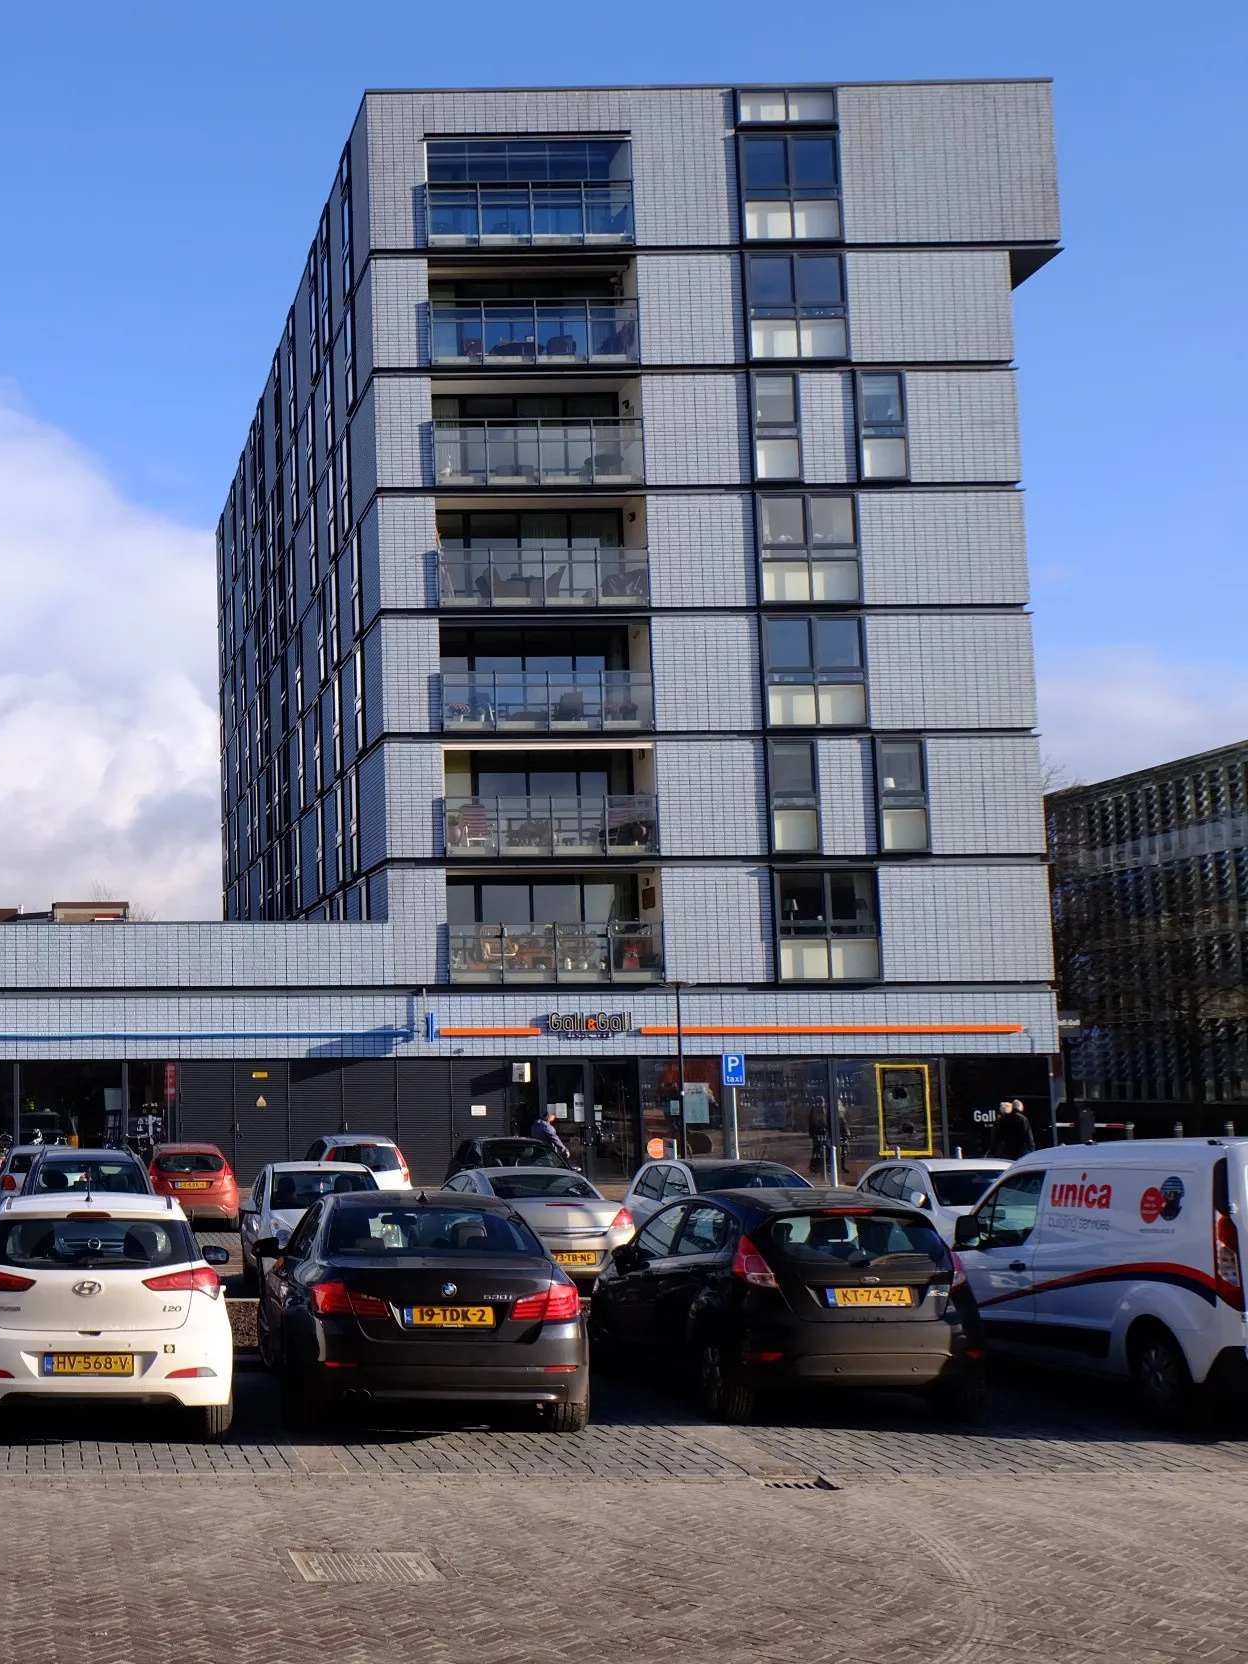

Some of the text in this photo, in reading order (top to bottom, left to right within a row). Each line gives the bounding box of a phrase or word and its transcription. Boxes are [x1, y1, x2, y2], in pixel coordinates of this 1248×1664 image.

[727, 1056, 740, 1073] P
[726, 1075, 743, 1083] taxi
[973, 1110, 996, 1122] Gall
[1051, 1172, 1112, 1209] unica
[842, 1289, 906, 1302] KT-742-Z
[162, 1304, 182, 1312] i20
[418, 1308, 487, 1322] 19-TDK-2
[57, 1355, 128, 1369] HV-568-V
